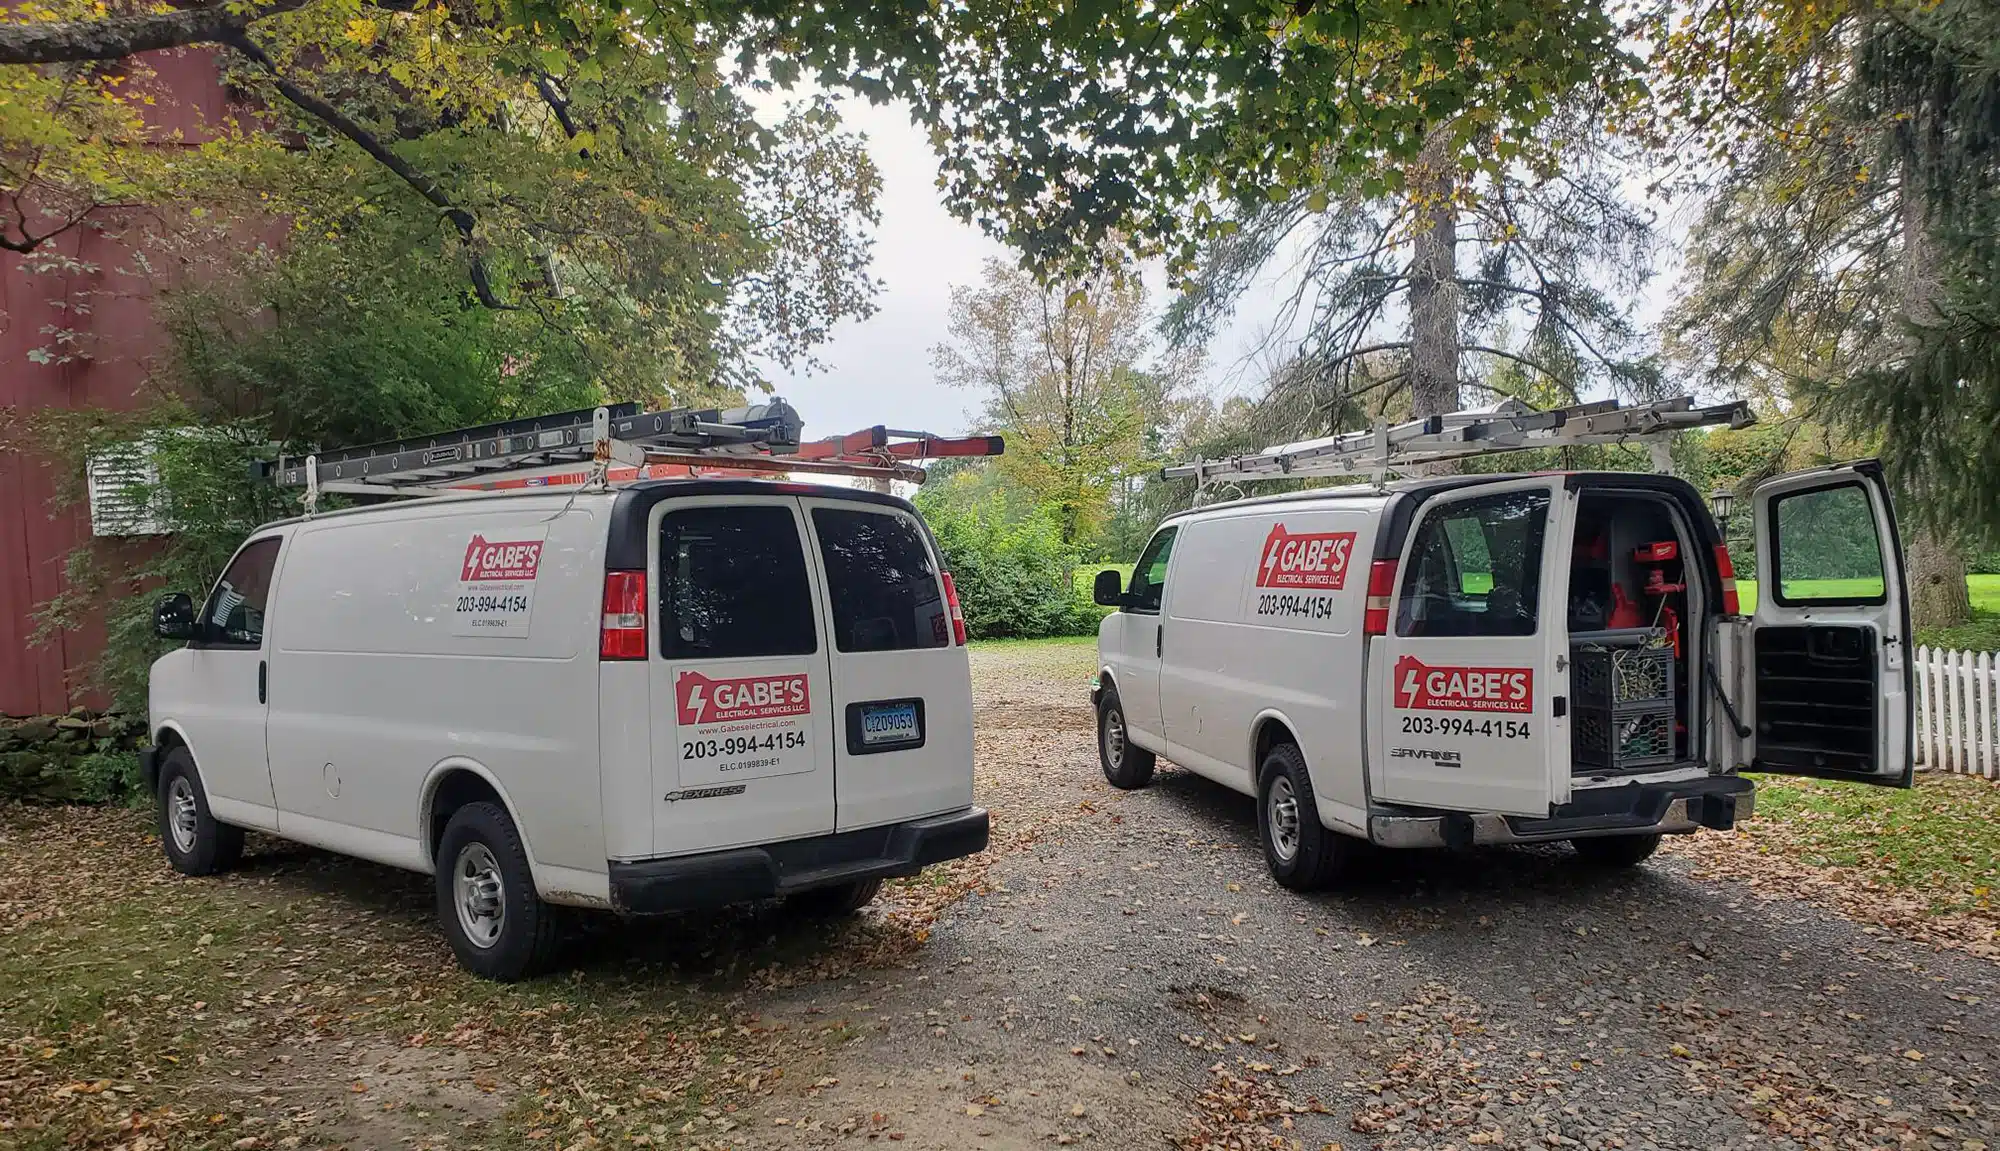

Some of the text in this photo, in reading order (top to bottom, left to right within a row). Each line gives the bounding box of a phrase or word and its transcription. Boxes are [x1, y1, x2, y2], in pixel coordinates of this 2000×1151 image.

[482, 545, 539, 570] GABE'S
[1280, 539, 1350, 572] GABE'S
[479, 570, 503, 578] ELECTRICAL
[504, 569, 525, 578] SERVICES
[1276, 574, 1303, 583] ELECTRICAL
[1305, 574, 1329, 584] SERVICES
[456, 596, 527, 612] 203-994-4154
[1258, 594, 1333, 619] 203-994-4154
[1425, 671, 1527, 700] GABE'S
[713, 679, 805, 709] GABE'S
[1427, 699, 1469, 708] ELECTRICAL
[1473, 699, 1509, 709] SERVICES
[716, 709, 757, 719] ELECTRICAL
[760, 705, 791, 715] SERVICES
[698, 720, 796, 735] www.Gabeselectrical.com
[1402, 716, 1531, 740] 203-994-4154
[683, 730, 805, 760] 203-994-4154
[1390, 748, 1461, 761] SAVANA
[719, 757, 781, 772] ELC.0199839-E1
[681, 785, 746, 800] EXPRESS
